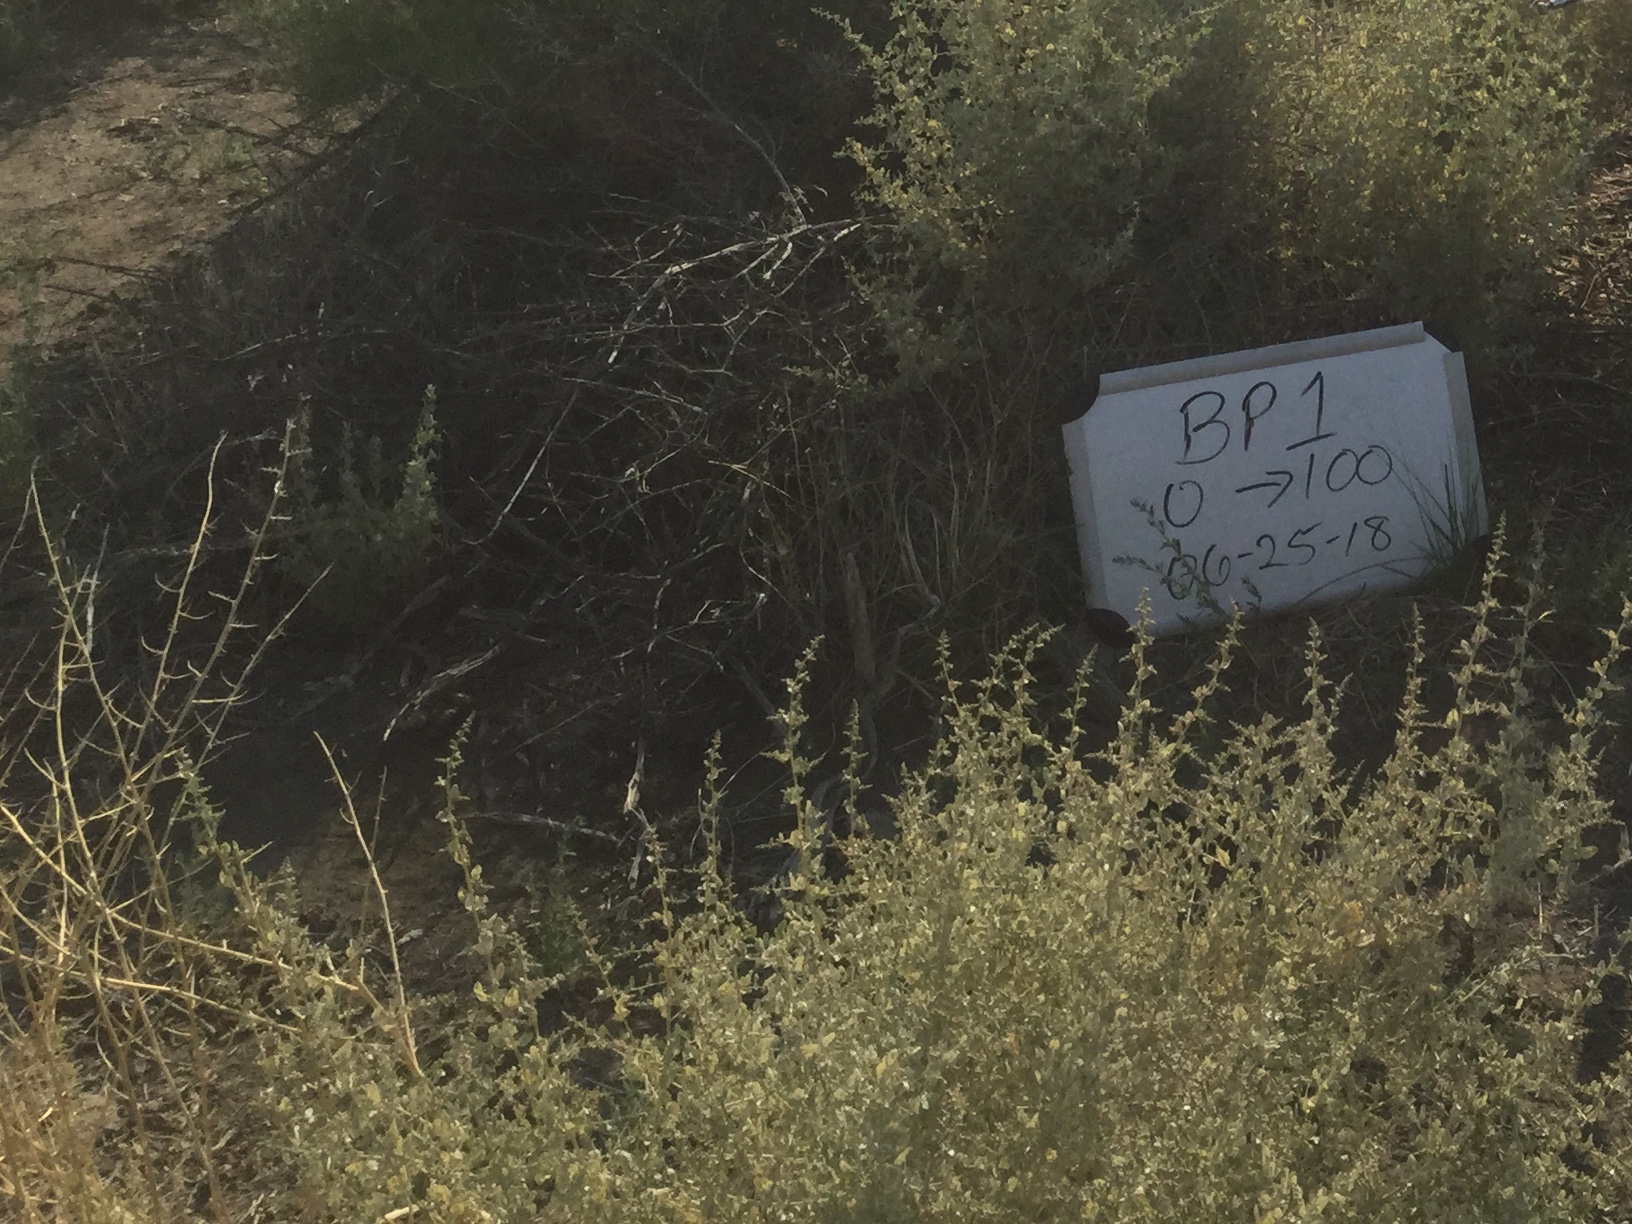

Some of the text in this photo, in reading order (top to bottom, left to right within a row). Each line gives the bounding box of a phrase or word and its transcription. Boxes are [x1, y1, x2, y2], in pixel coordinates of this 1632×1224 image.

[1163, 444, 1393, 528] 0 100
[1166, 515, 1392, 601] 06-25-18
